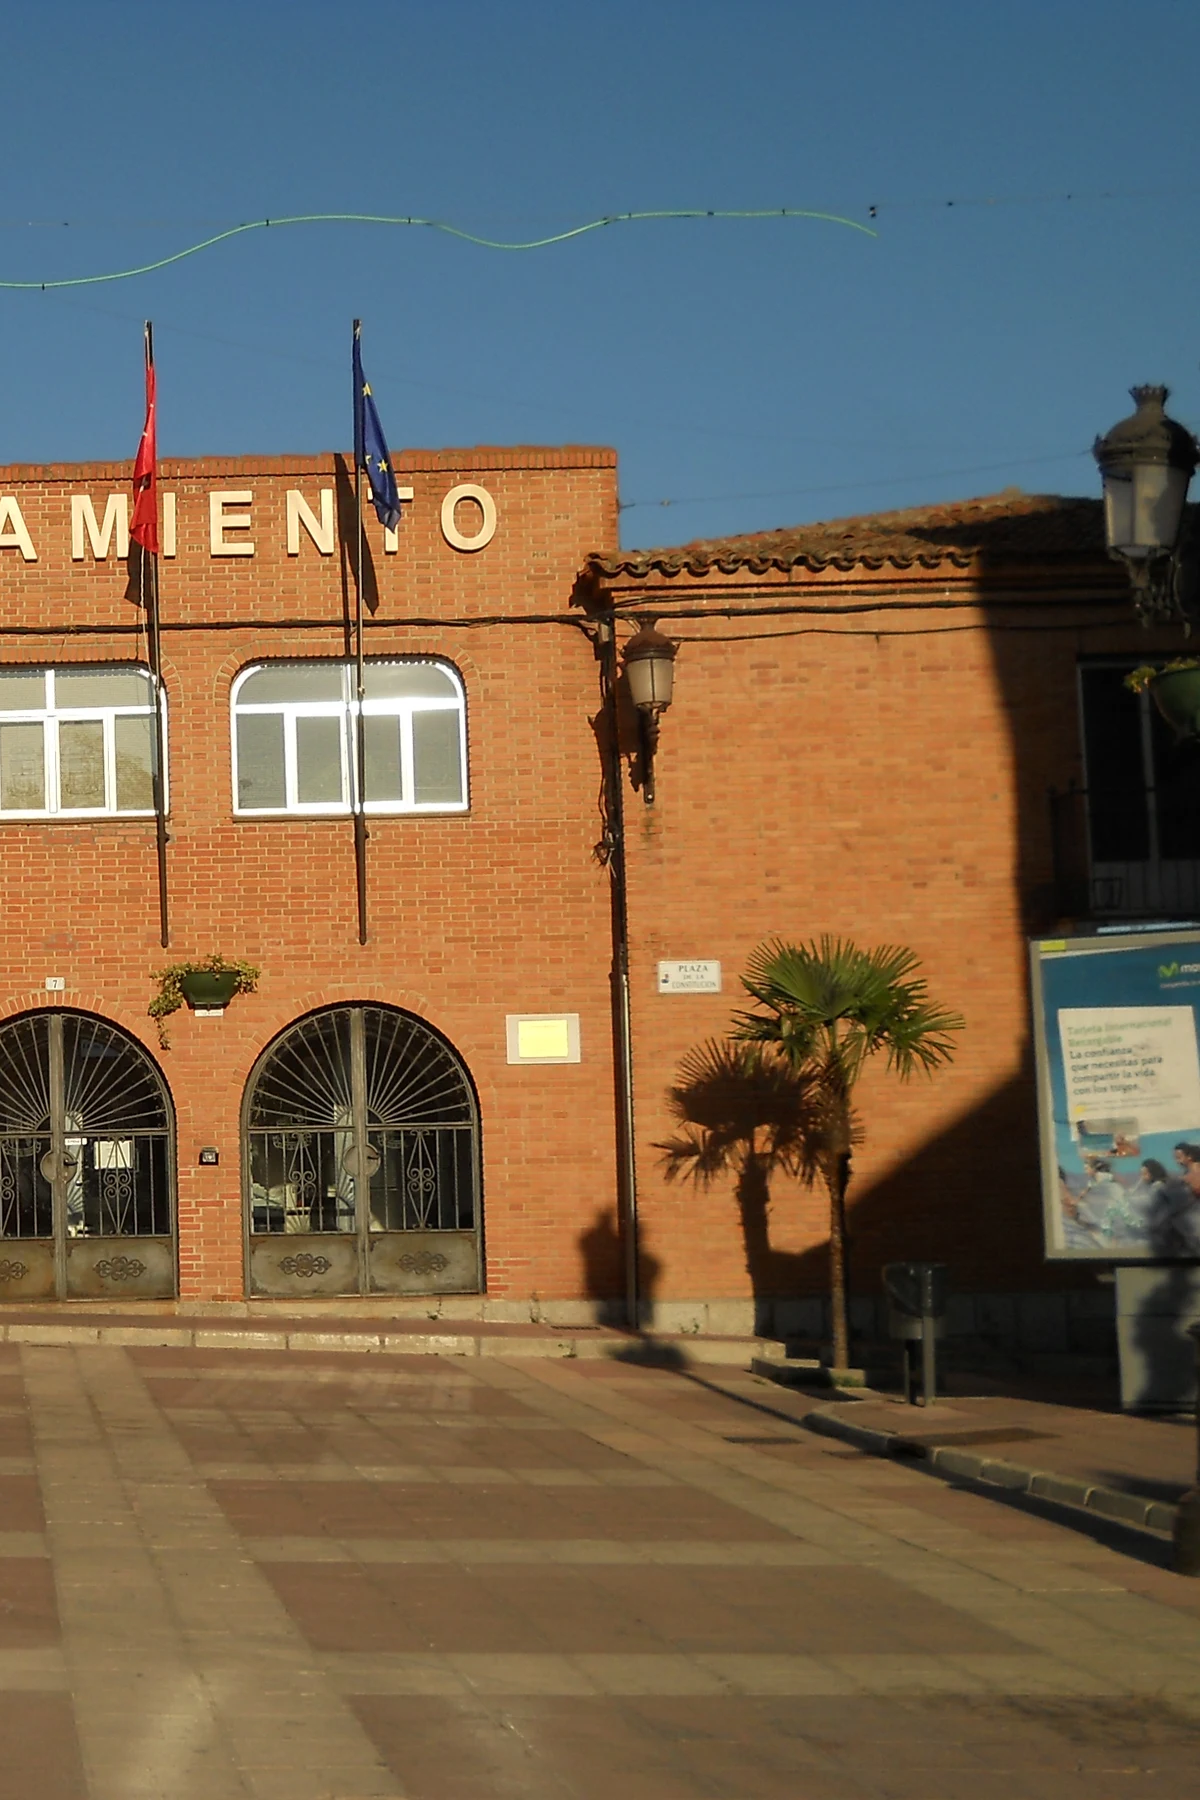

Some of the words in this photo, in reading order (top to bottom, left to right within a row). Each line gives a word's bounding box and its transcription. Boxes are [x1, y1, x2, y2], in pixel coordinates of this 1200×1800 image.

[678, 964, 708, 973] PLAZA
[52, 979, 58, 988] 7
[1069, 1050, 1082, 1060] La
[1084, 1046, 1133, 1058] confianza
[1071, 1063, 1089, 1072] que
[1091, 1058, 1139, 1069] necesitas
[1141, 1055, 1163, 1067] para
[1072, 1072, 1120, 1083] compartir
[1122, 1069, 1132, 1078] la
[1073, 1087, 1091, 1095] con
[1093, 1085, 1108, 1094] los
